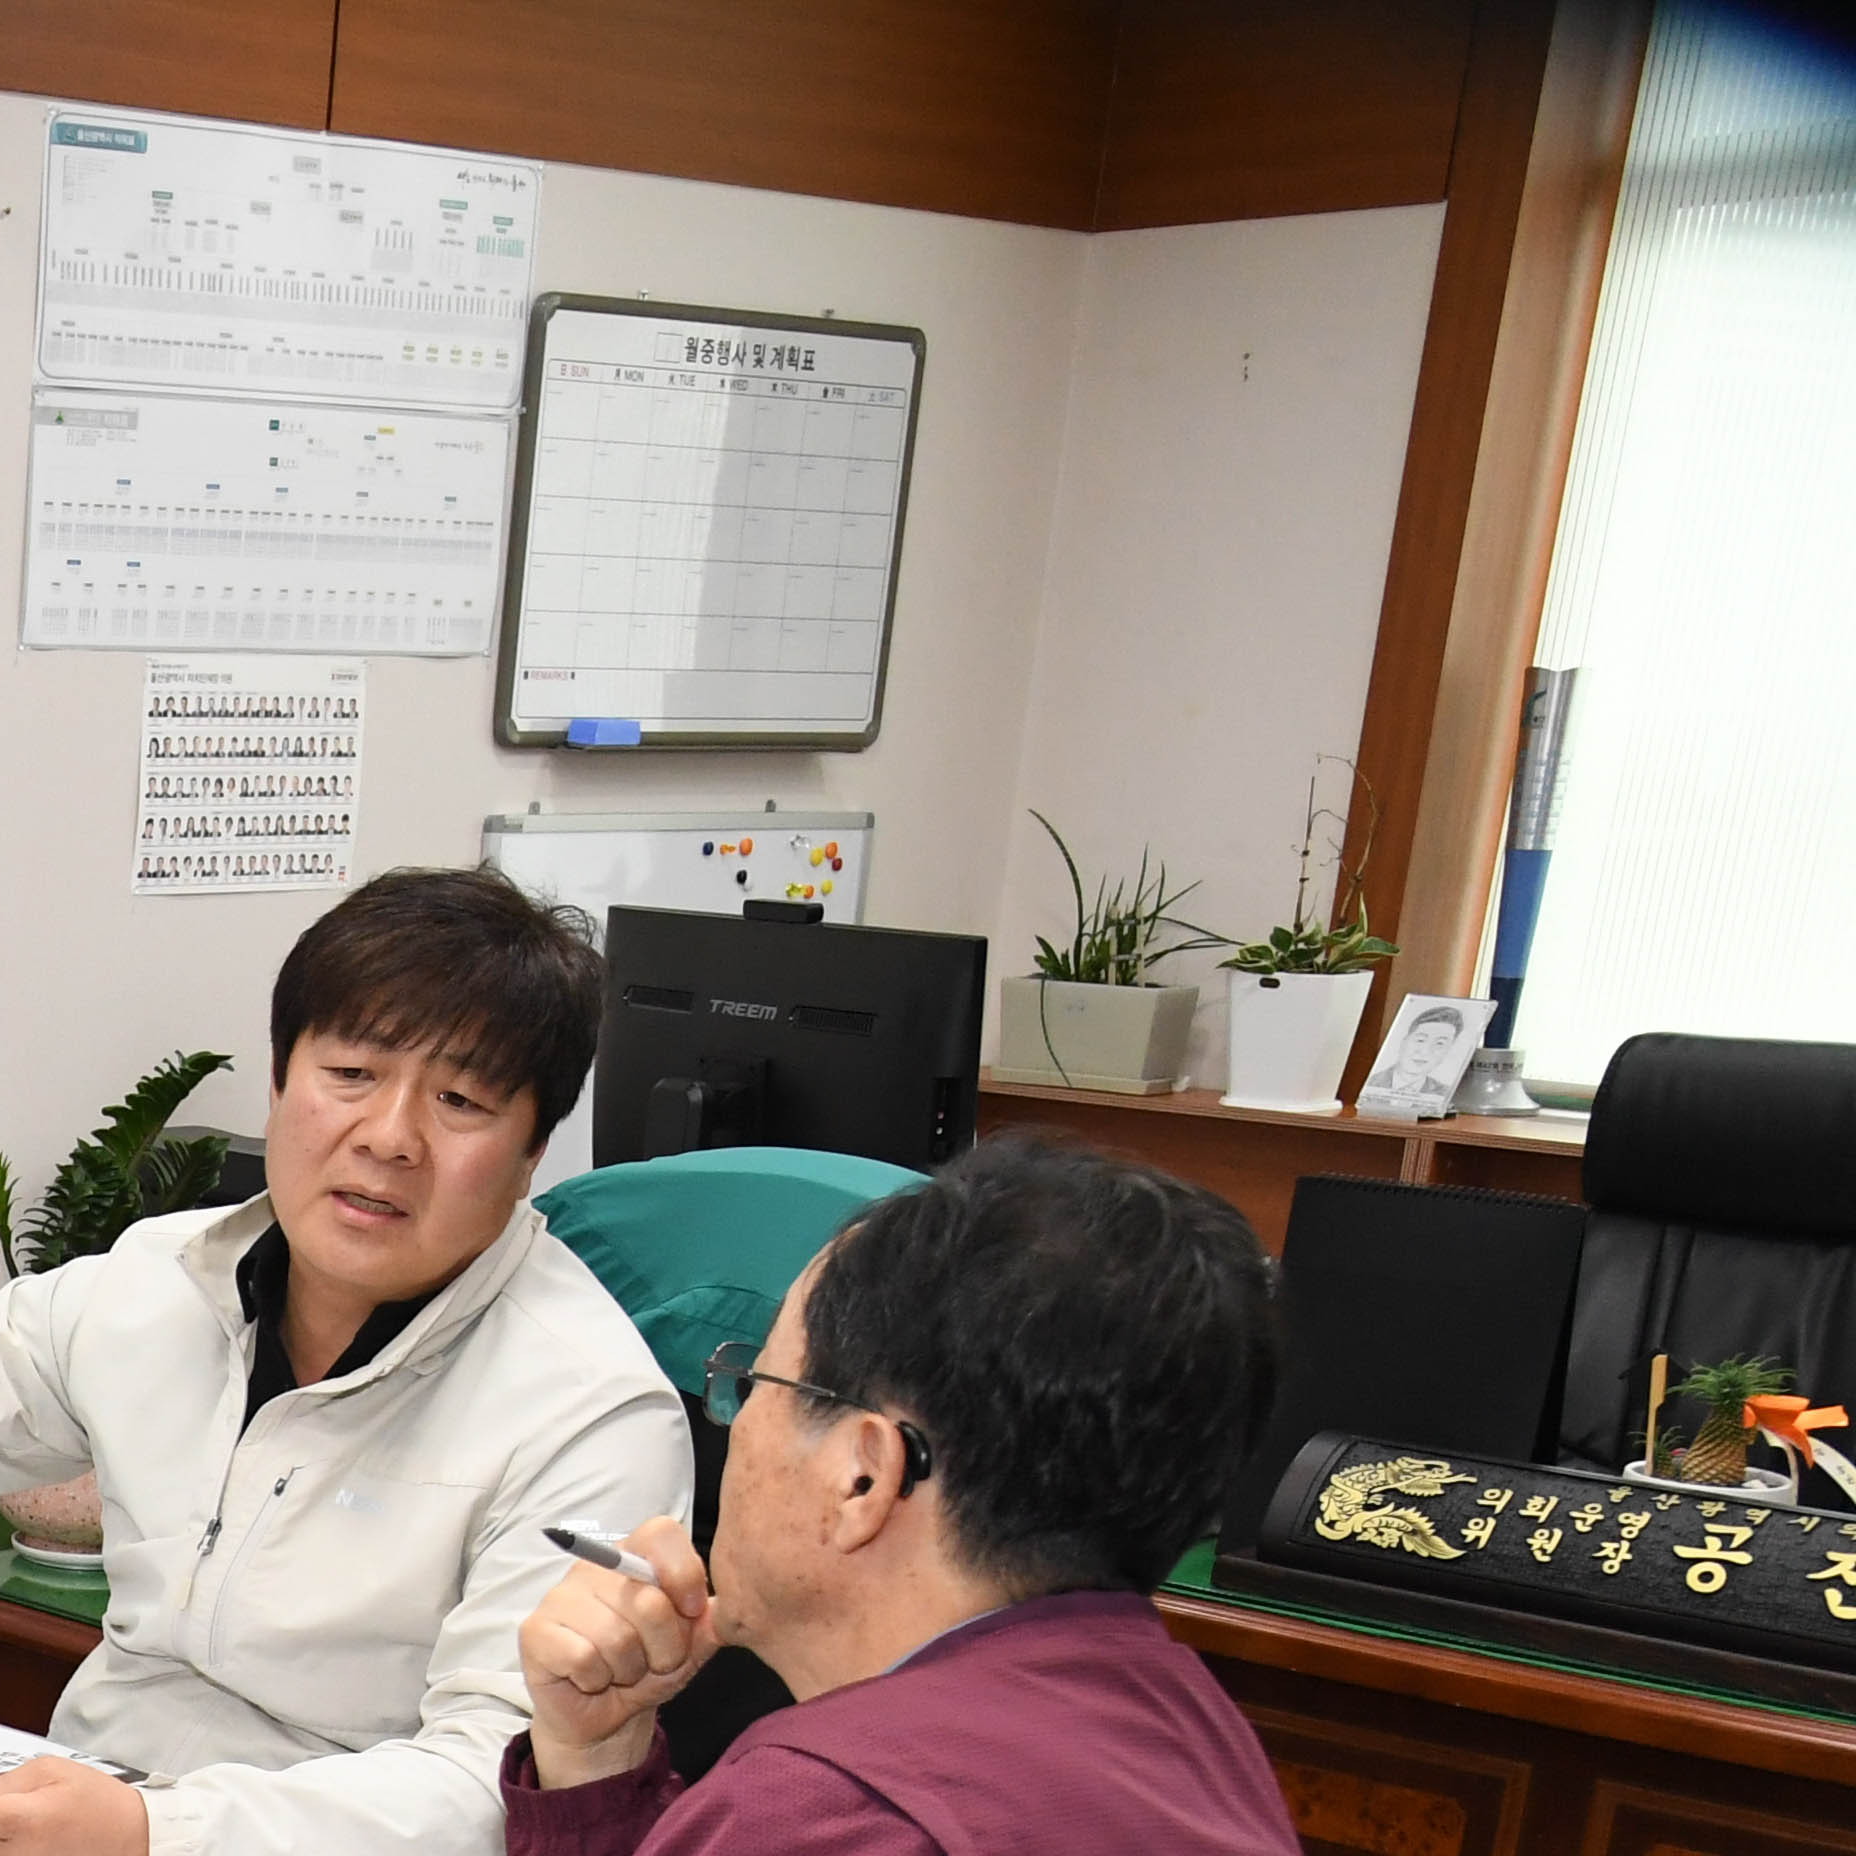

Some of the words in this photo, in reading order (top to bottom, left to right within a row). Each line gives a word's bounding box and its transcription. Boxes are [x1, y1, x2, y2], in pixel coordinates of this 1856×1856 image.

[684, 336, 747, 367] 월중행사
[753, 344, 766, 369] 및
[769, 345, 816, 372] 계획표
[571, 365, 589, 378] SUN
[624, 369, 644, 383] MON
